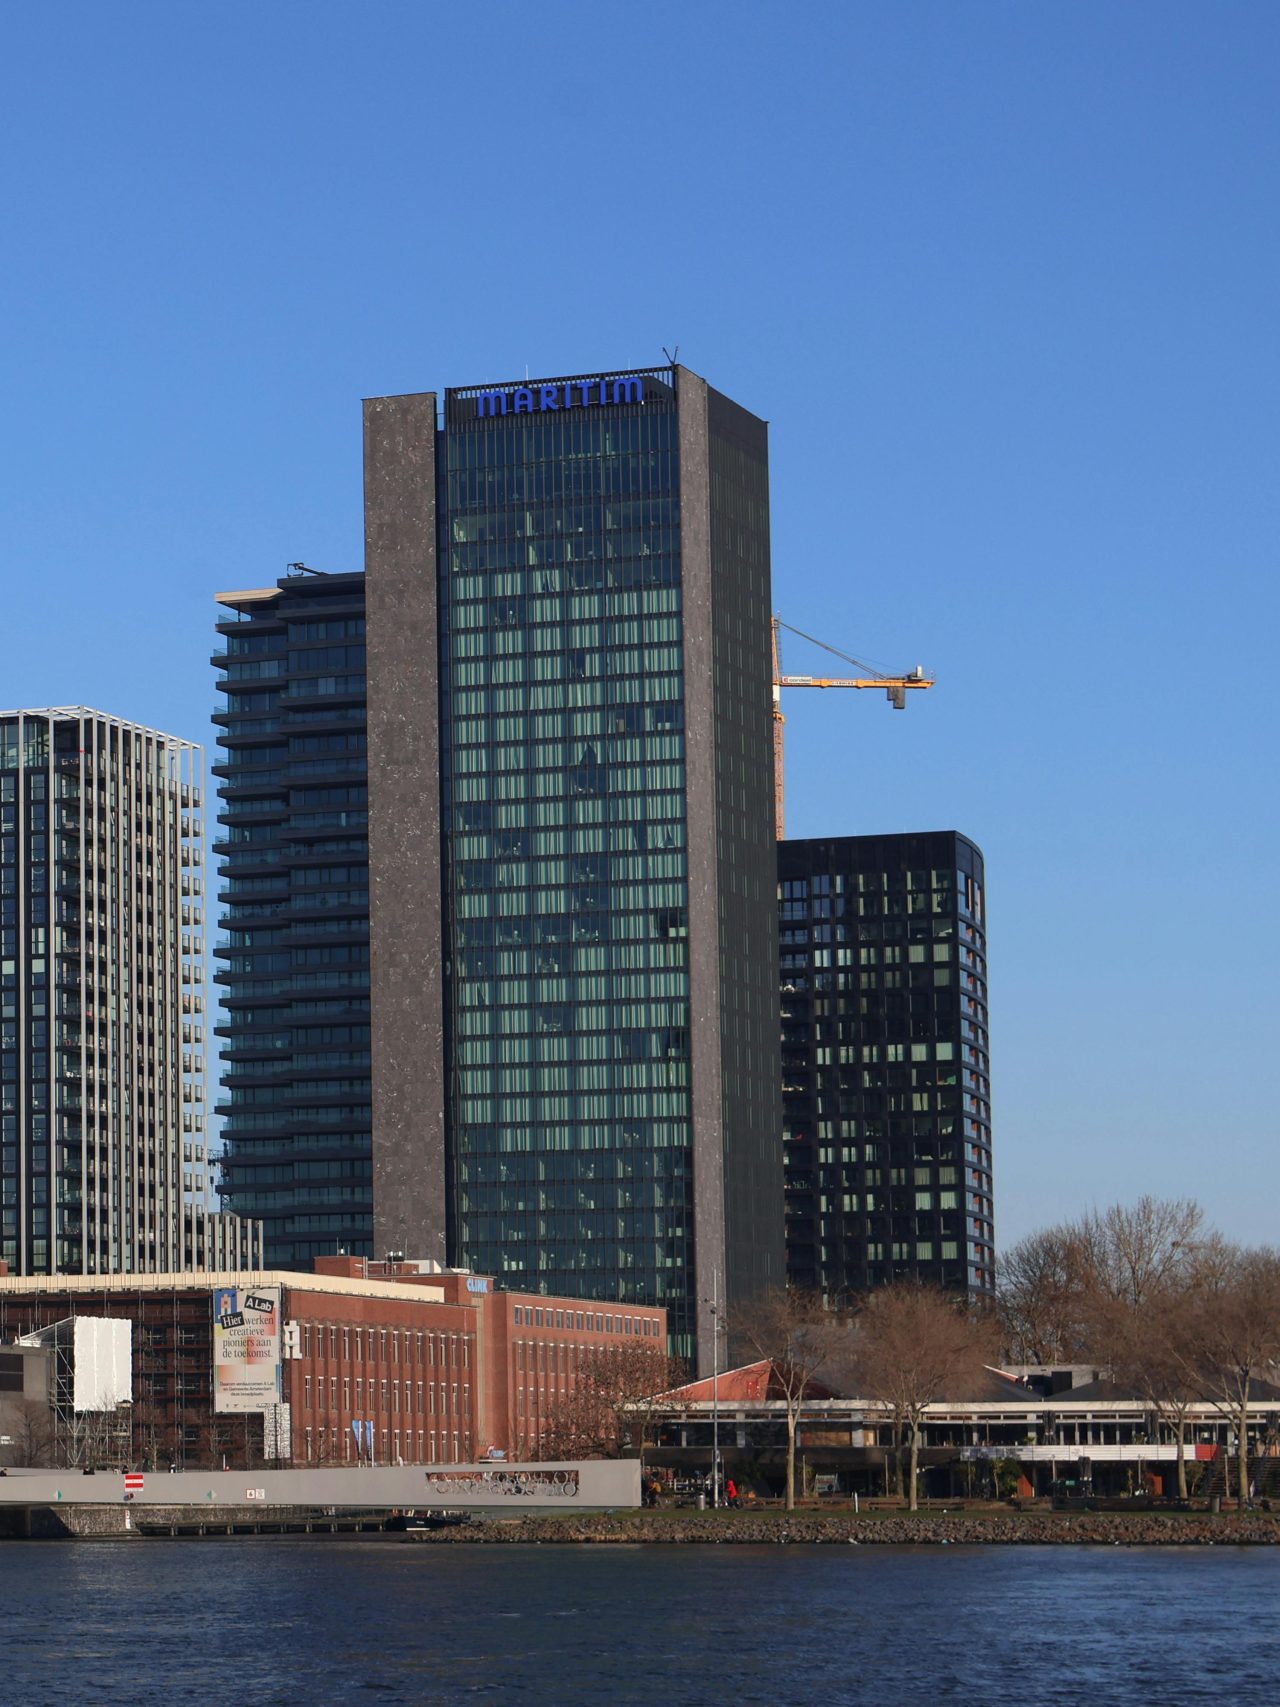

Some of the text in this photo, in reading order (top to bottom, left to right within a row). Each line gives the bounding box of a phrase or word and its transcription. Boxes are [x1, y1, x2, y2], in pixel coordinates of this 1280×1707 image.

[478, 377, 643, 417] MARITIM
[246, 1298, 272, 1312] A Lab
[223, 1315, 274, 1327] Hier werken
[229, 1326, 265, 1336] creatieve
[222, 1338, 272, 1349] pioniers aan
[222, 1348, 273, 1358] de toekomst.
